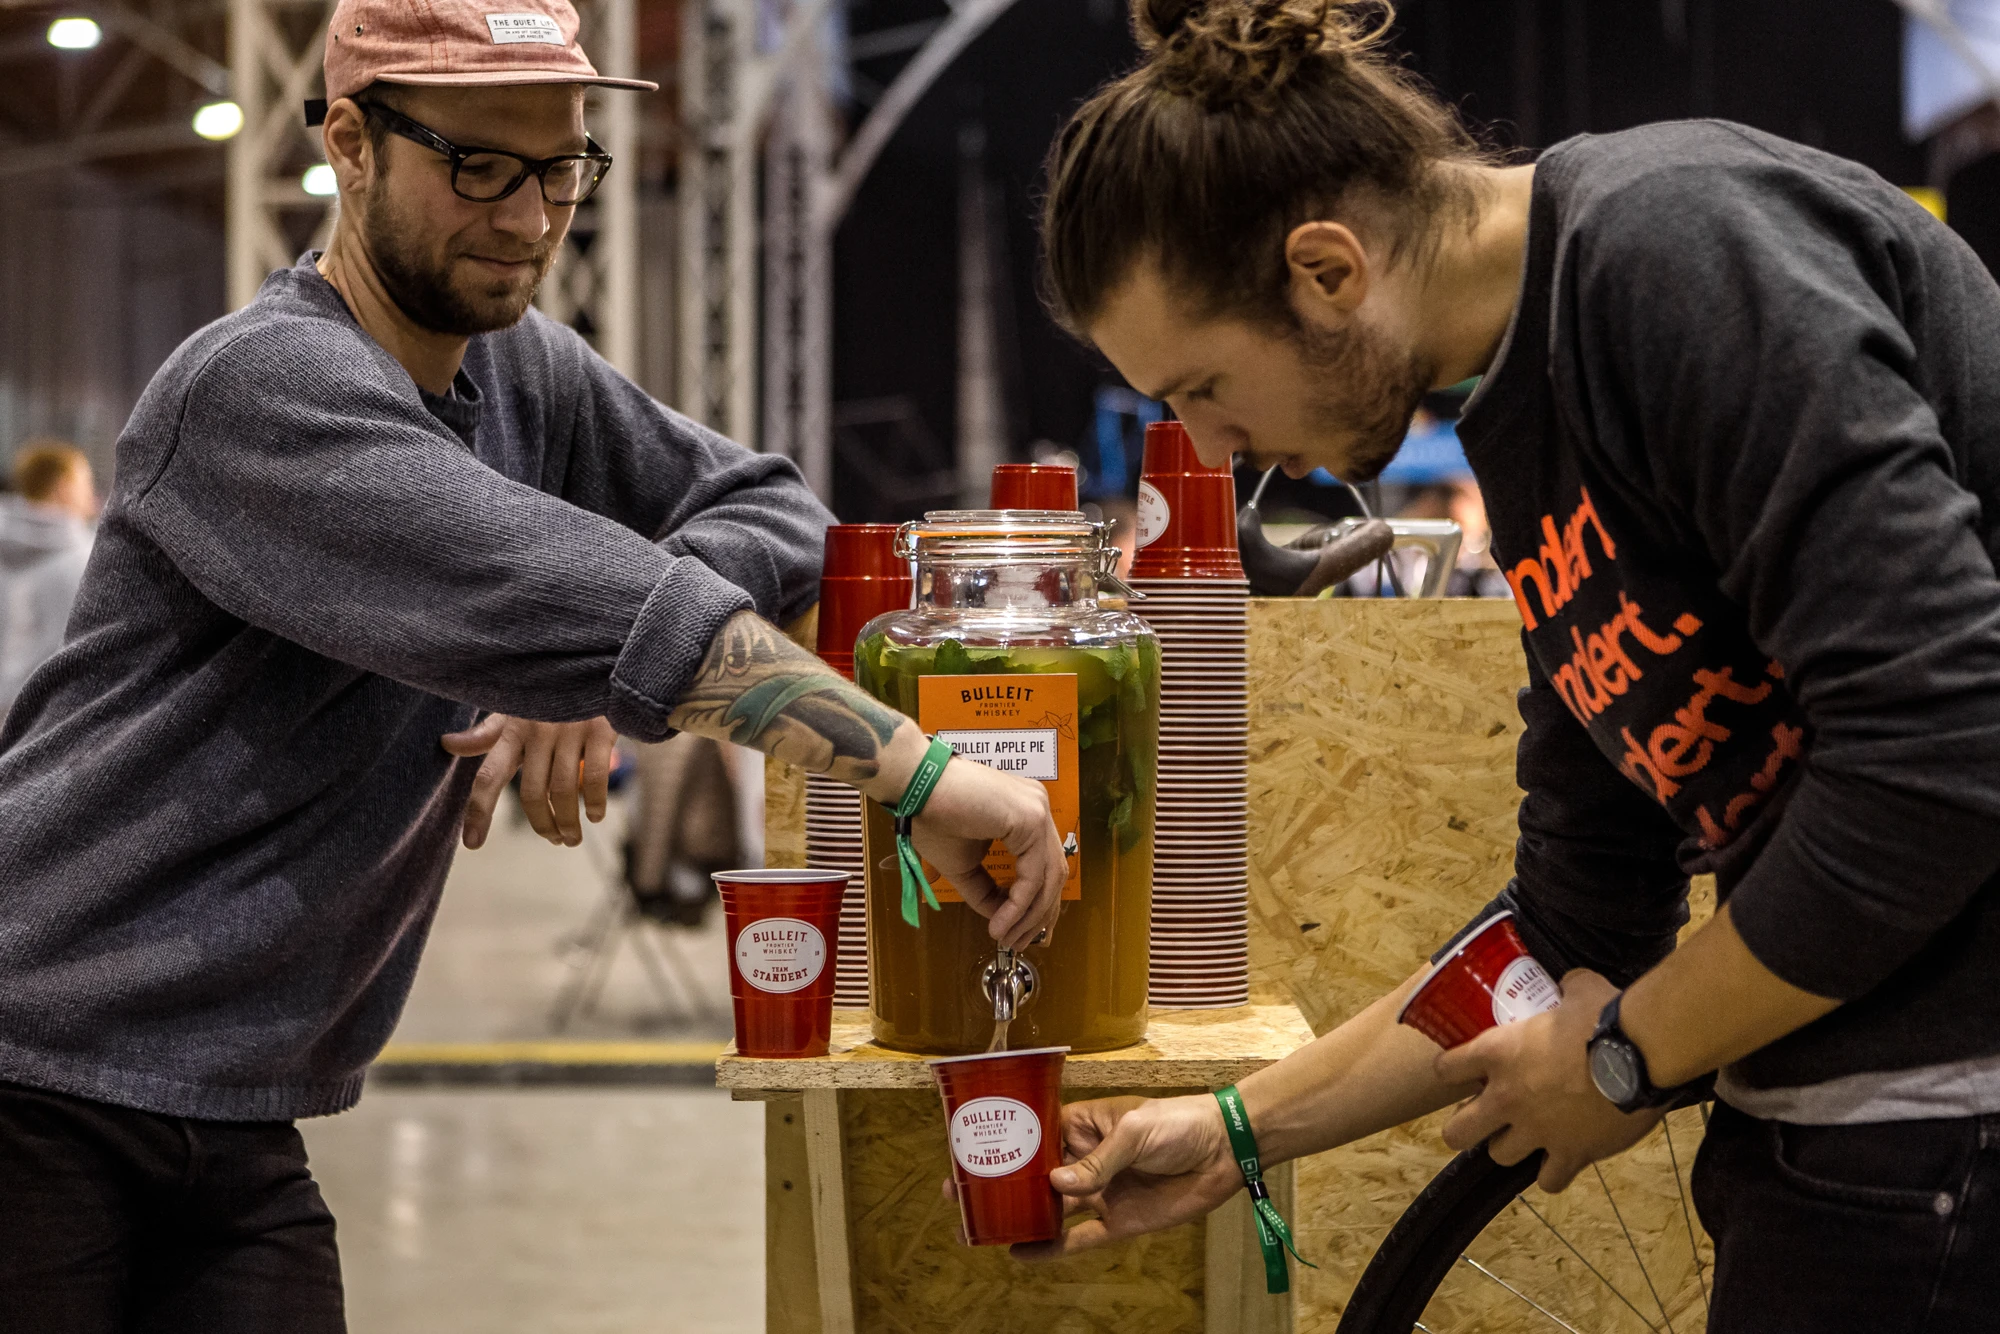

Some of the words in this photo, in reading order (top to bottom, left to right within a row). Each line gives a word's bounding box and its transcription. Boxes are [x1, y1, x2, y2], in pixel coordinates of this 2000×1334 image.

[493, 19, 509, 27] THE
[513, 19, 536, 27] QUIET
[961, 686, 1034, 703] BULLEIT
[975, 709, 1021, 717] WHISKEY
[995, 741, 1026, 753] APPLE
[1030, 740, 1045, 753] PIE
[997, 758, 1028, 771] JULEP
[753, 967, 808, 982] STANDERT
[1225, 1095, 1245, 1132] TicketPAY
[973, 1128, 1008, 1137] WHISKEY
[975, 1122, 1003, 1130] FRONTIER
[967, 1147, 1023, 1166] STANDERT
[984, 1148, 1001, 1156] TEAM
